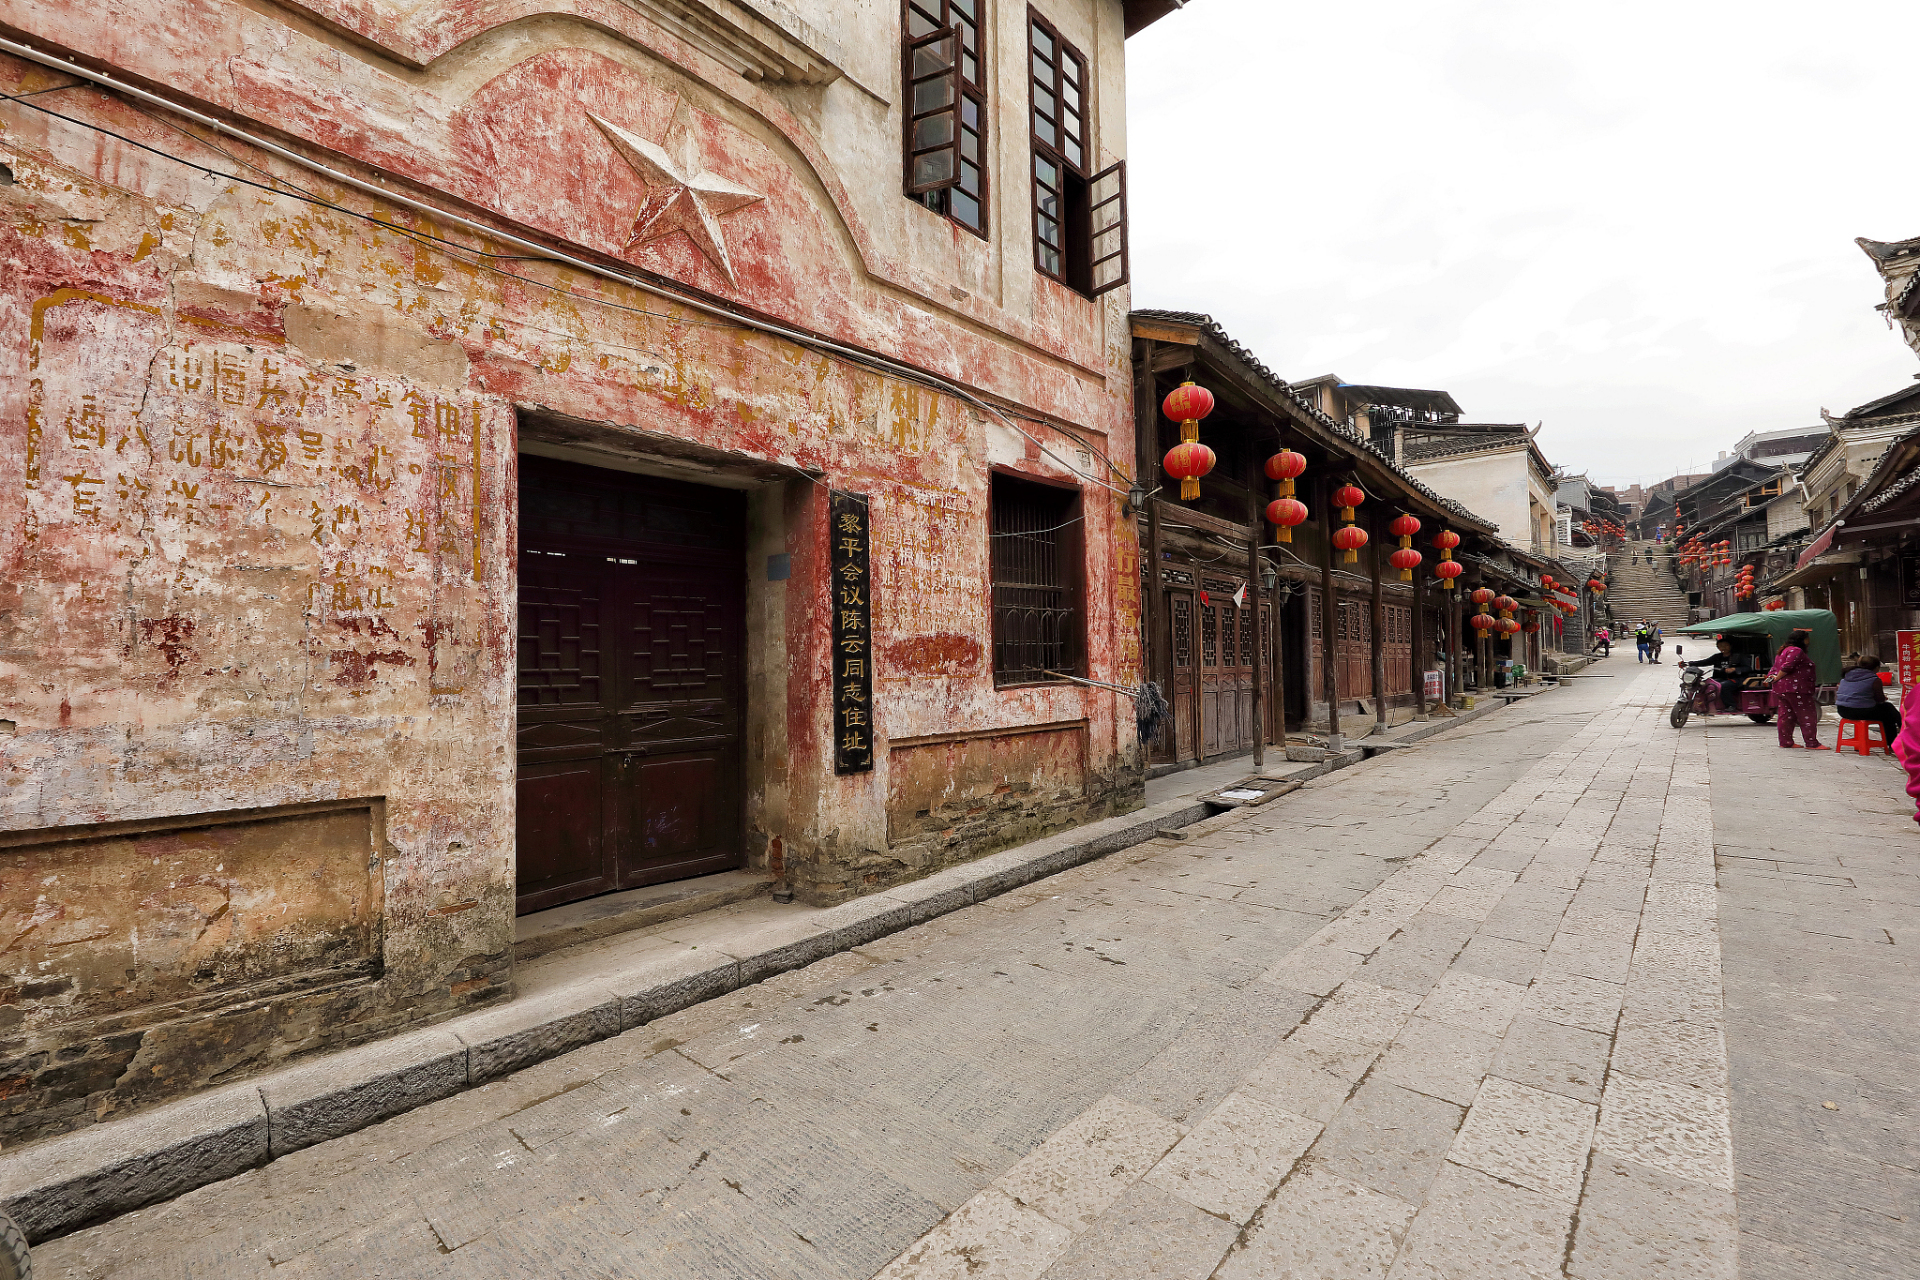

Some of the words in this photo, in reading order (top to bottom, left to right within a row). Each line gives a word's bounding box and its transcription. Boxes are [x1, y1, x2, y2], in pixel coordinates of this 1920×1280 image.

[837, 512, 867, 751] 黎平会议陈云同志住址
[1902, 643, 1911, 662] 牛肉粉
[1902, 664, 1912, 683] 羊肉粉
